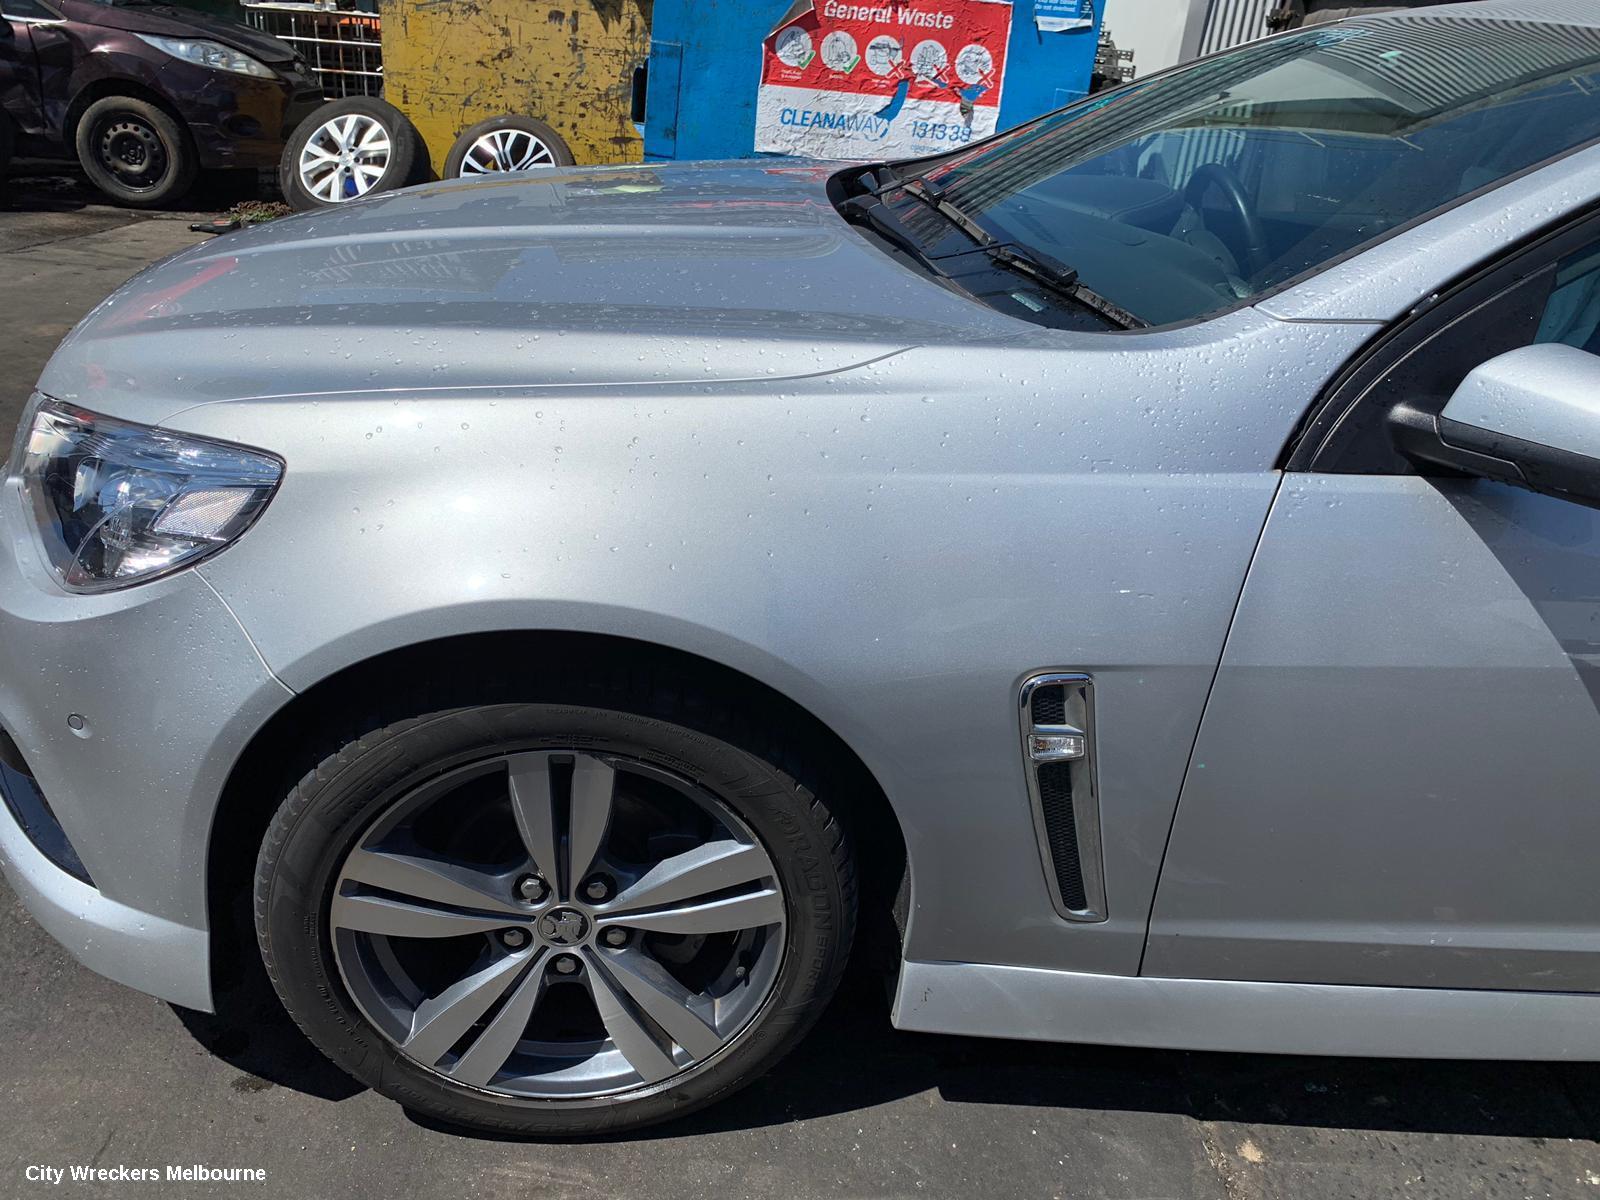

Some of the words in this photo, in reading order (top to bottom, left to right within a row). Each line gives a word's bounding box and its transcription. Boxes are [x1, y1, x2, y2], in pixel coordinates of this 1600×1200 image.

[823, 0, 894, 23] General
[897, 6, 954, 29] Waste
[780, 108, 884, 134] CLEANAWAY
